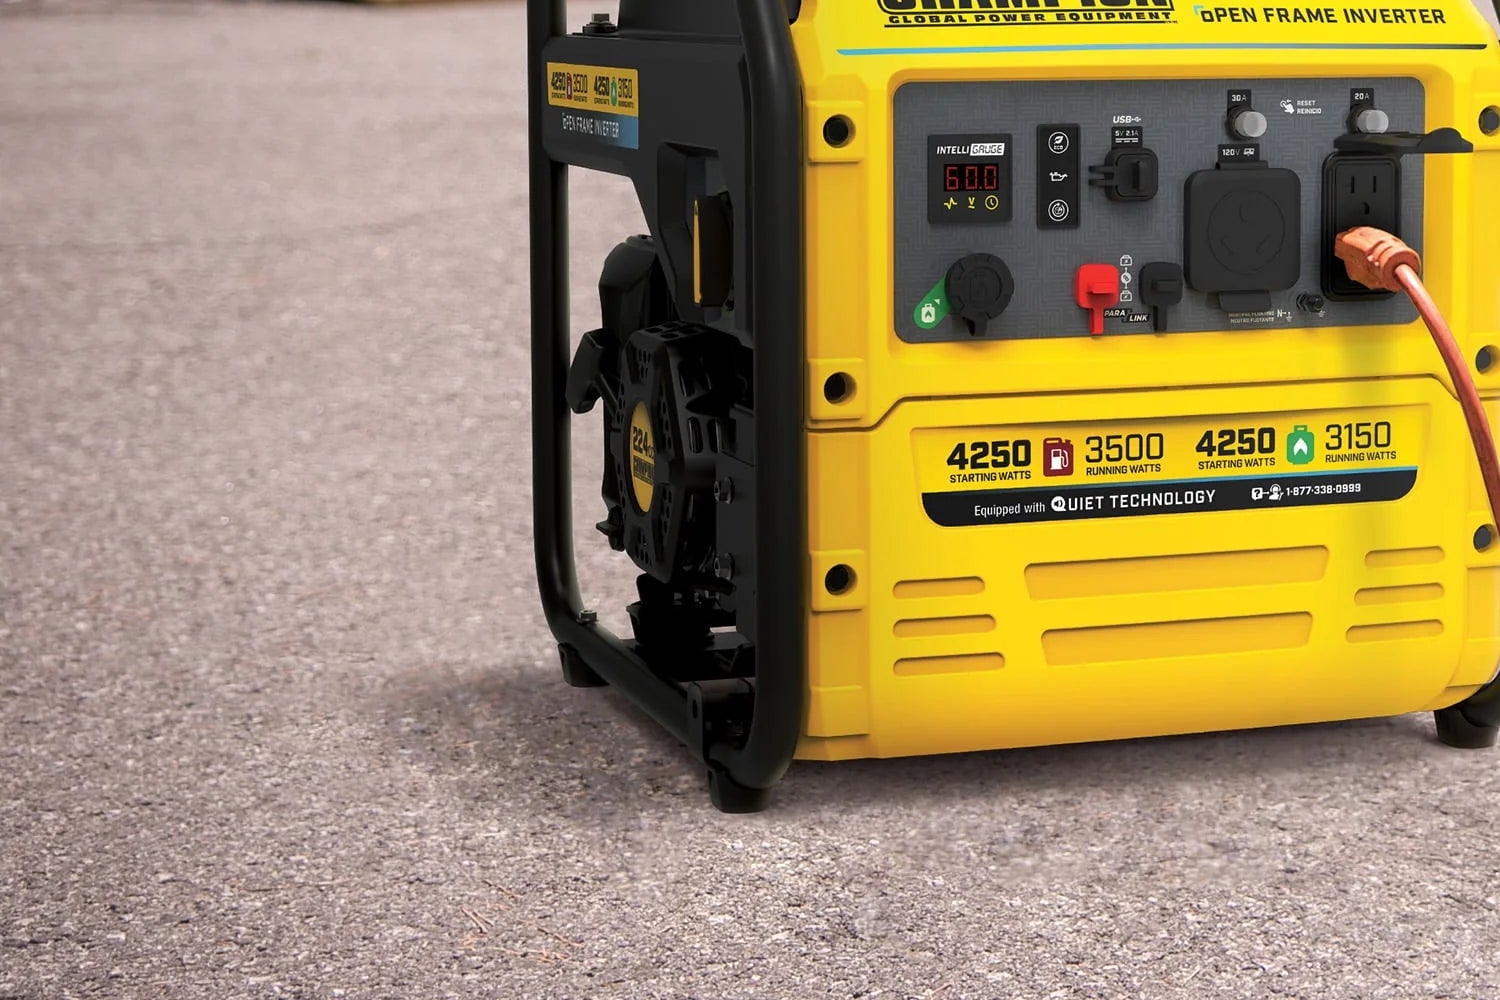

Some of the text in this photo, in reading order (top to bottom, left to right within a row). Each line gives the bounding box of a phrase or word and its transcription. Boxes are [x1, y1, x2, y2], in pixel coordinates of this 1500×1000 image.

[888, 11, 1171, 24] GLOBAL POWER EQUIPMENT
[1263, 7, 1338, 24] FRAME
[1343, 8, 1446, 24] INVERTER
[946, 165, 997, 190] 60.0
[946, 421, 1391, 471] 4250 3500 4250 3150
[1198, 457, 1276, 470] STARTING WATTS
[1325, 450, 1397, 463] RUNNING WATTS
[950, 470, 1032, 484] STARTING WATTS
[1086, 463, 1162, 477] RUNNING WATTS
[974, 489, 1216, 518] Equipped with QUIET TECHNOLOGY
